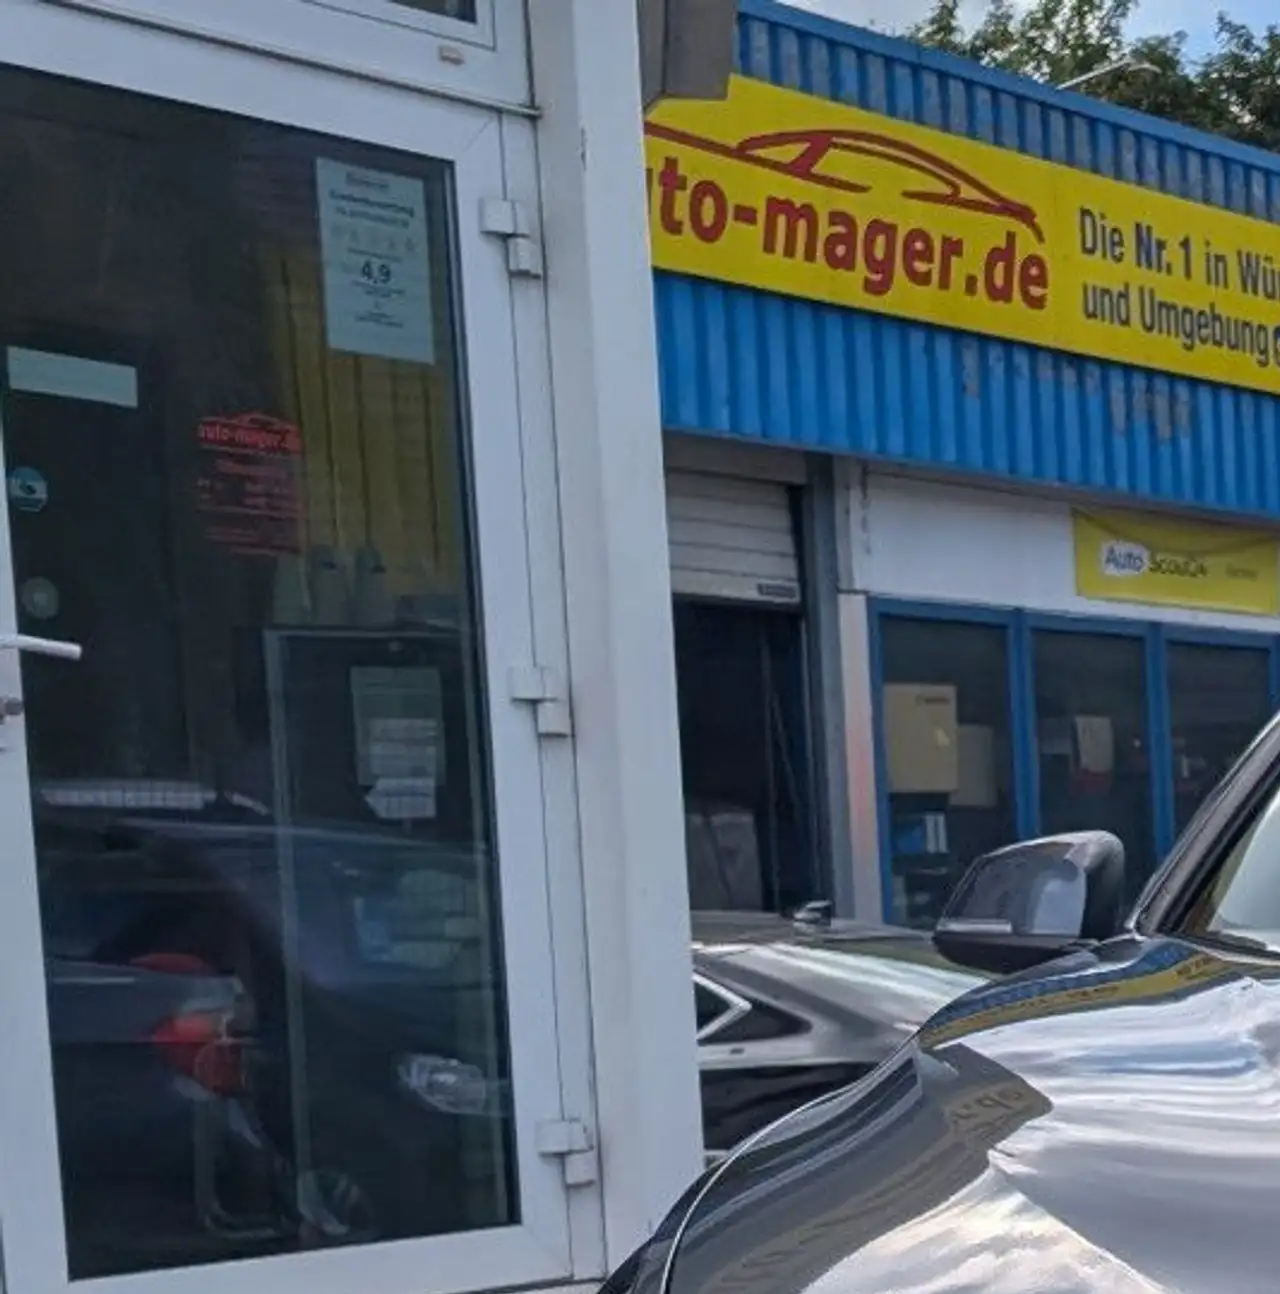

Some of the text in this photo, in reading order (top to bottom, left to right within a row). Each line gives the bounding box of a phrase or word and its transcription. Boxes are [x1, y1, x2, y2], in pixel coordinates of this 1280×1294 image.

[646, 157, 1049, 310] to-mager.de
[1080, 206, 1125, 263] Die
[1135, 222, 1172, 275] Nr.
[1178, 235, 1192, 279] 1
[1204, 240, 1228, 290] in
[1082, 281, 1131, 328] und
[1139, 286, 1270, 368] Umgebung
